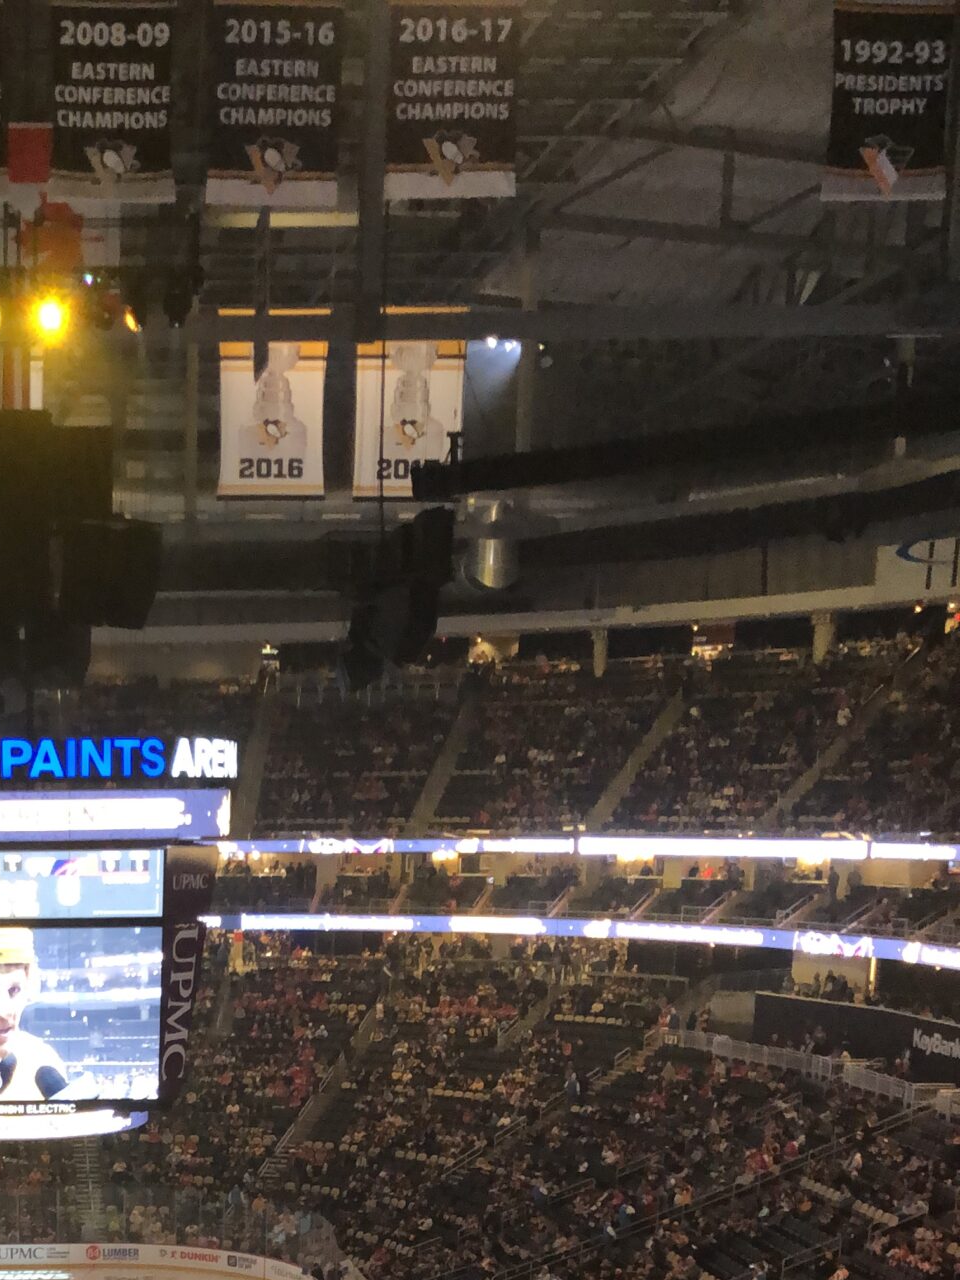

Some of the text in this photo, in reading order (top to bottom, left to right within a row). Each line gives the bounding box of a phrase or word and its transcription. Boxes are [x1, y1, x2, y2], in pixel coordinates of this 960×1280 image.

[59, 20, 170, 47] 2008-09
[224, 18, 335, 46] 2015-16
[399, 17, 513, 43] 2016-17
[840, 39, 945, 64] 1992-93
[72, 62, 154, 81] EASTERN
[235, 58, 319, 78] EASTERN
[412, 55, 497, 74] EASTERN
[216, 82, 335, 103] CONFERENCE
[393, 78, 514, 98] CONFERENCE
[835, 73, 943, 92] PRESIDENTS
[54, 84, 171, 104] CONFERENCE
[396, 102, 509, 121] CHAMPIONS
[852, 97, 928, 115] TROPHY
[56, 109, 168, 129] CHAMPIONS
[219, 107, 331, 127] CHAMPIONS
[239, 458, 303, 479] 2016
[1, 737, 166, 779] PAINTS
[173, 873, 208, 890] UPMC
[162, 925, 199, 1081] UPMC
[26, 1103, 76, 1115] ELECTRIC
[102, 1248, 139, 1258] LUMBER
